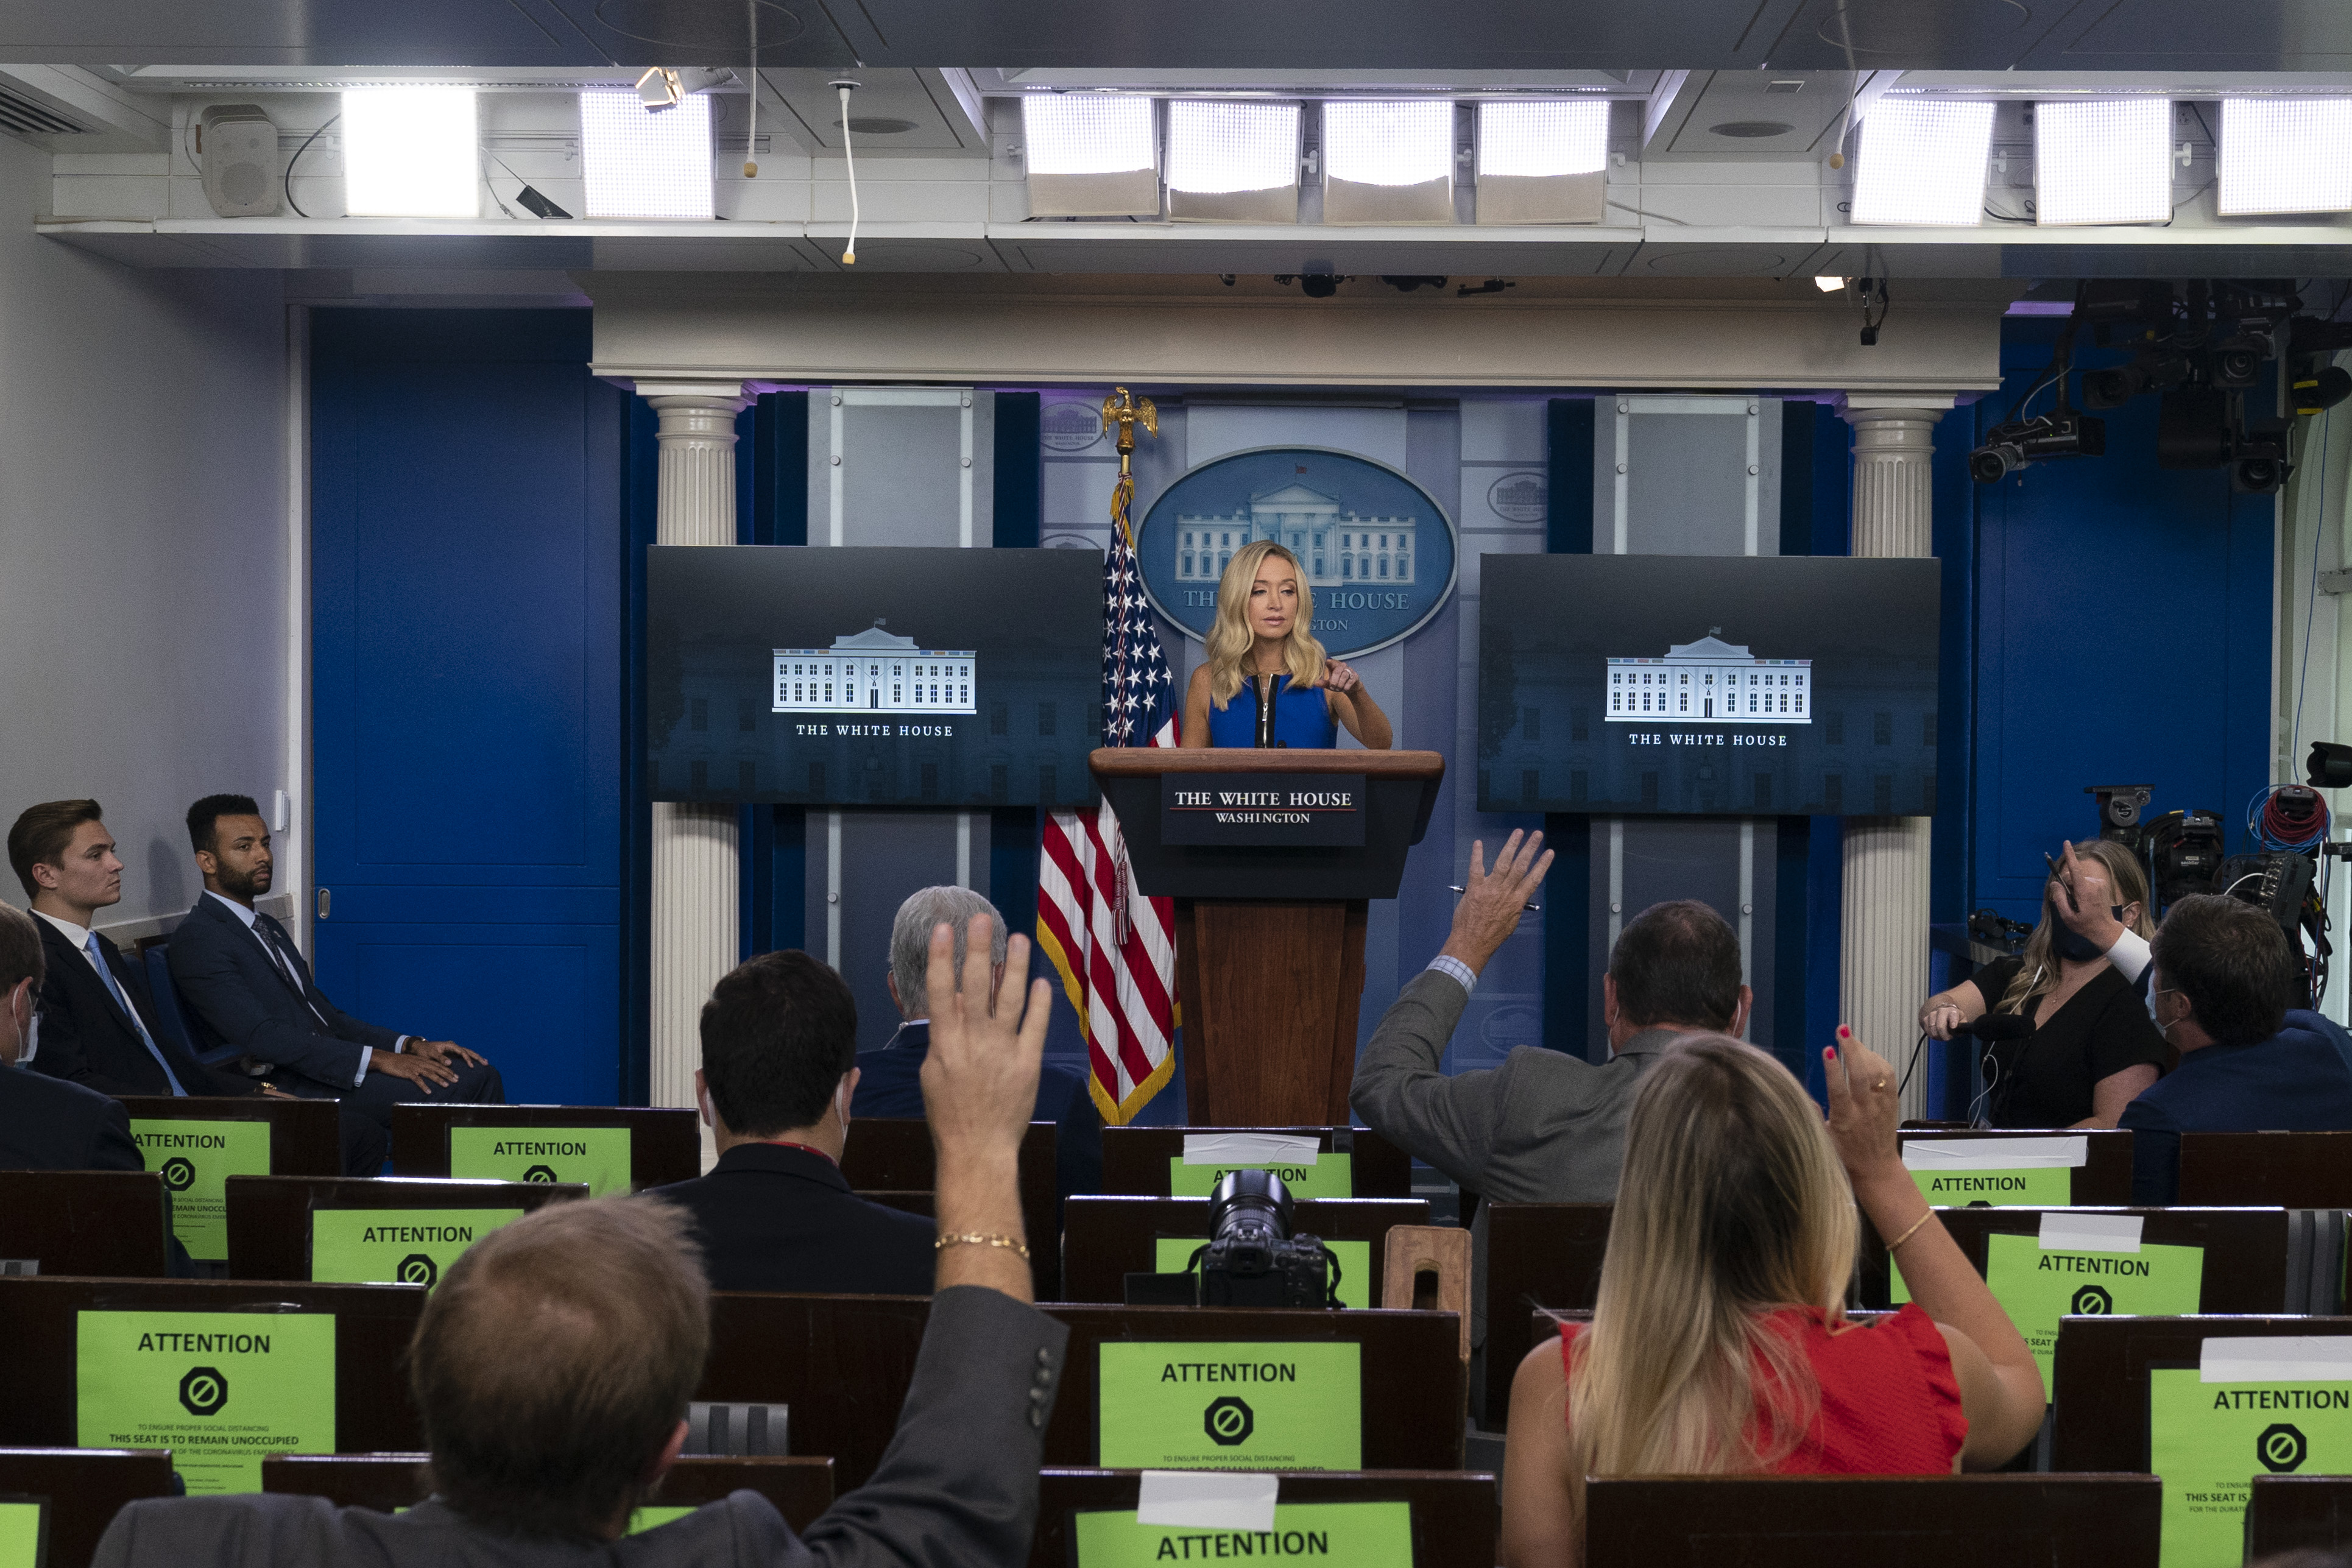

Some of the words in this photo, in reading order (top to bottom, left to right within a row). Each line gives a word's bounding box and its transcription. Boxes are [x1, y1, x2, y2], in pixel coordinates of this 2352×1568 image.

[1183, 590, 1215, 607] TH
[1330, 592, 1410, 610] HOUSE
[796, 724, 828, 735] THE
[836, 725, 891, 736] WHITE
[899, 726, 953, 736] HOUSE
[1629, 733, 1661, 744] THE
[1670, 734, 1725, 745] WHITE
[1733, 735, 1787, 746] HOUSE
[1175, 792, 1212, 805] THE
[1218, 792, 1280, 806] WHITE
[1289, 792, 1352, 806] HOUSE
[1215, 813, 1310, 824] WASHINGTON
[135, 1134, 225, 1149] ATTENTION
[493, 1142, 586, 1156] ATTENTION
[1932, 1176, 2026, 1192] ATTENTION
[362, 1226, 473, 1243] ATTENTION
[2038, 1254, 2150, 1277] ATTENTION
[138, 1332, 270, 1354] ATTENTION
[2030, 1338, 2052, 1346] SEAT
[1161, 1363, 1296, 1382] ATTENTION
[2214, 1390, 2350, 1410] ATTENTION
[109, 1434, 131, 1443] THIS
[133, 1435, 157, 1444] SEAT
[160, 1435, 169, 1444] IS
[172, 1435, 185, 1444] TO
[188, 1435, 228, 1445] REMAIN
[231, 1436, 298, 1446] UNOCCUPIED
[2186, 1492, 2208, 1502] THIS
[2211, 1493, 2236, 1502] SEAT
[2239, 1493, 2247, 1502] IS
[1157, 1531, 1328, 1560] ATTENTION
